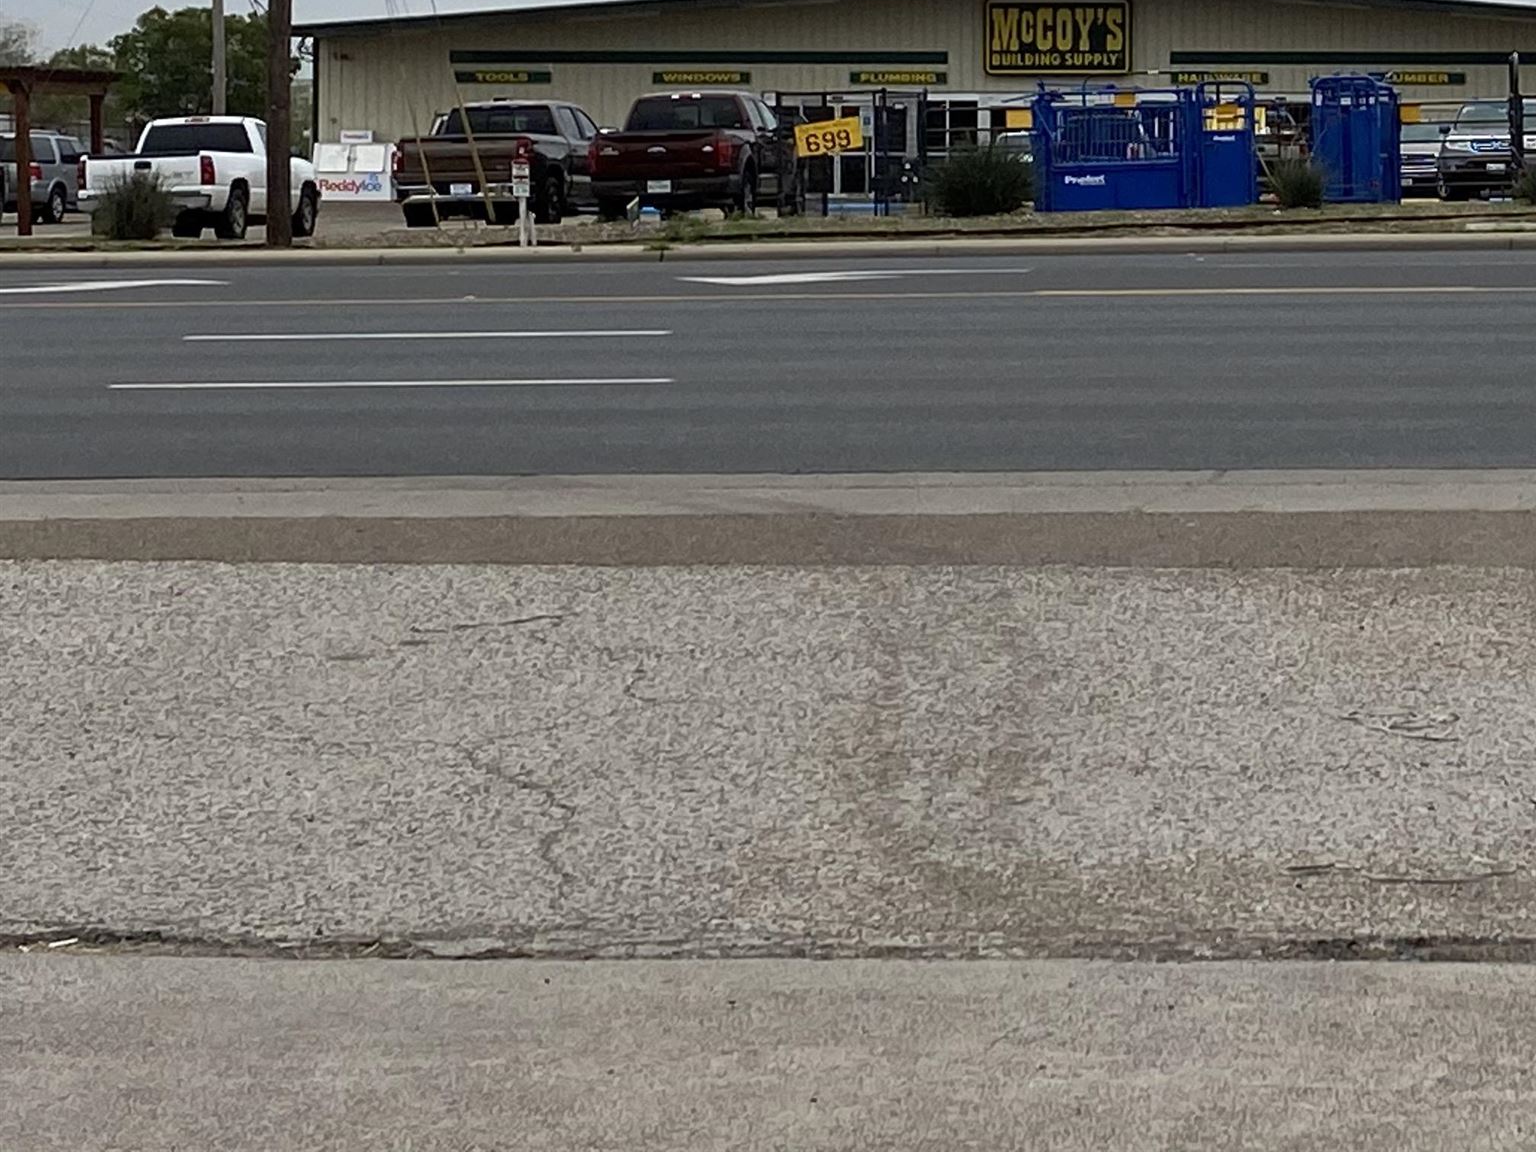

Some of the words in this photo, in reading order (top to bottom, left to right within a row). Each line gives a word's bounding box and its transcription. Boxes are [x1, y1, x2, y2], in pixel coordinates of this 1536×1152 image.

[992, 8, 1123, 51] McCOY'S
[992, 53, 1061, 66] BUILDING
[1065, 53, 1118, 66] SUPPLY
[475, 72, 529, 82] TOOLS
[662, 73, 741, 82] WINDOWS
[860, 73, 938, 82] PLUMBING
[805, 129, 852, 153] 699
